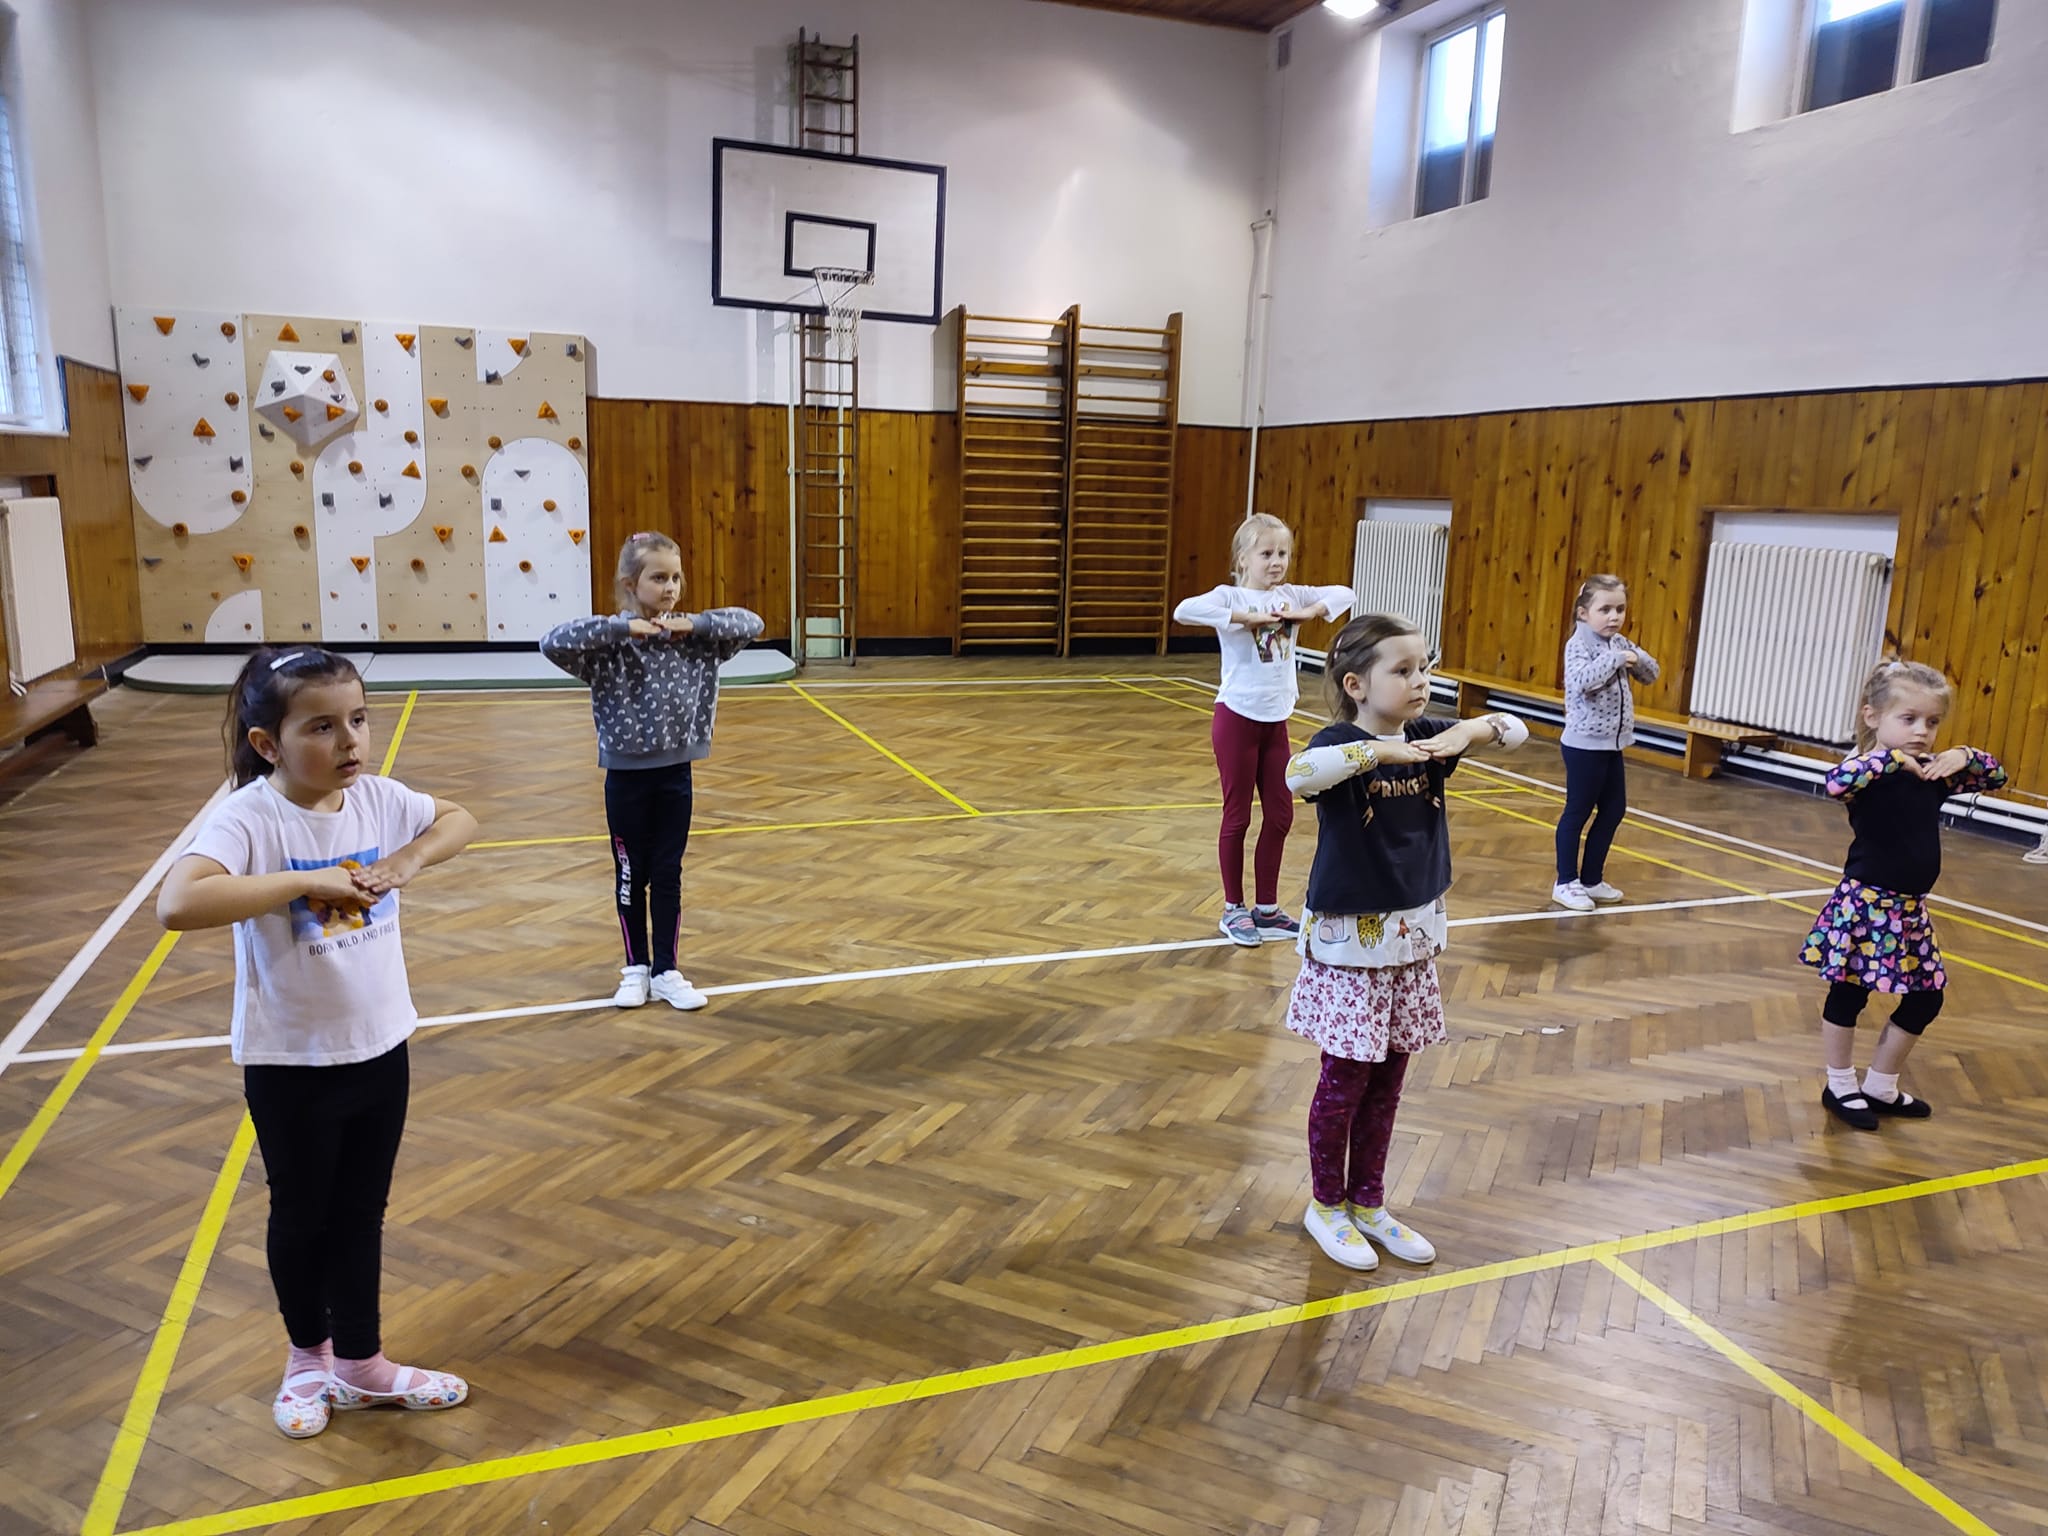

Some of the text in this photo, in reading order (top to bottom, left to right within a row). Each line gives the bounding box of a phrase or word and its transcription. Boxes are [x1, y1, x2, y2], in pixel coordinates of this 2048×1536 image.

[308, 921, 396, 956] BORN WILD AND FREE
